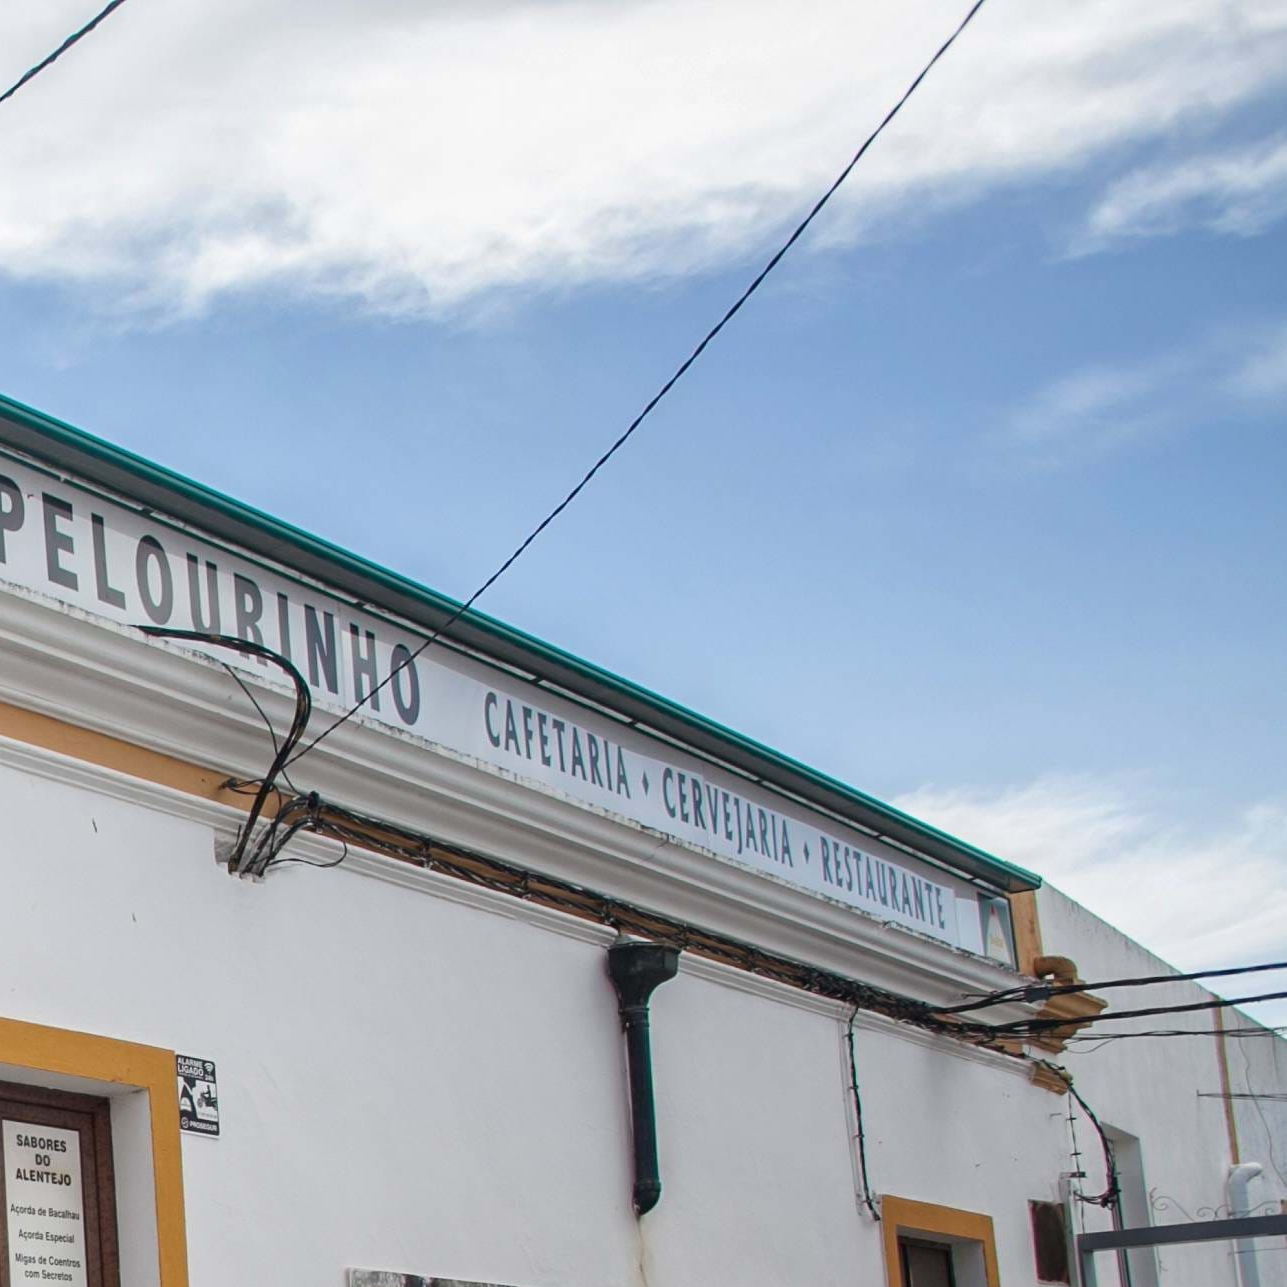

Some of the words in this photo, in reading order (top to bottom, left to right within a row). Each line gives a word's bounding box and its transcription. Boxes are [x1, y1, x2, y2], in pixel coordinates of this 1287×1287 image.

[484, 691, 631, 800] CAFETARIA
[662, 766, 794, 868] CERVEJARIA
[820, 835, 946, 930] RESTAURANTE
[178, 1064, 204, 1077] LIGADO
[16, 1134, 67, 1153] SABORES
[35, 1154, 51, 1167] DO
[15, 1168, 72, 1187] ALENTEJO
[10, 1203, 36, 1217] Açorda
[37, 1206, 47, 1216] de
[48, 1207, 80, 1221] Bacalhau
[18, 1229, 44, 1242] Açorda
[45, 1231, 75, 1244] Especial
[15, 1252, 36, 1266] Migas
[38, 1255, 47, 1265] de
[49, 1256, 81, 1268] Coentros
[41, 1270, 73, 1282] Secretos
